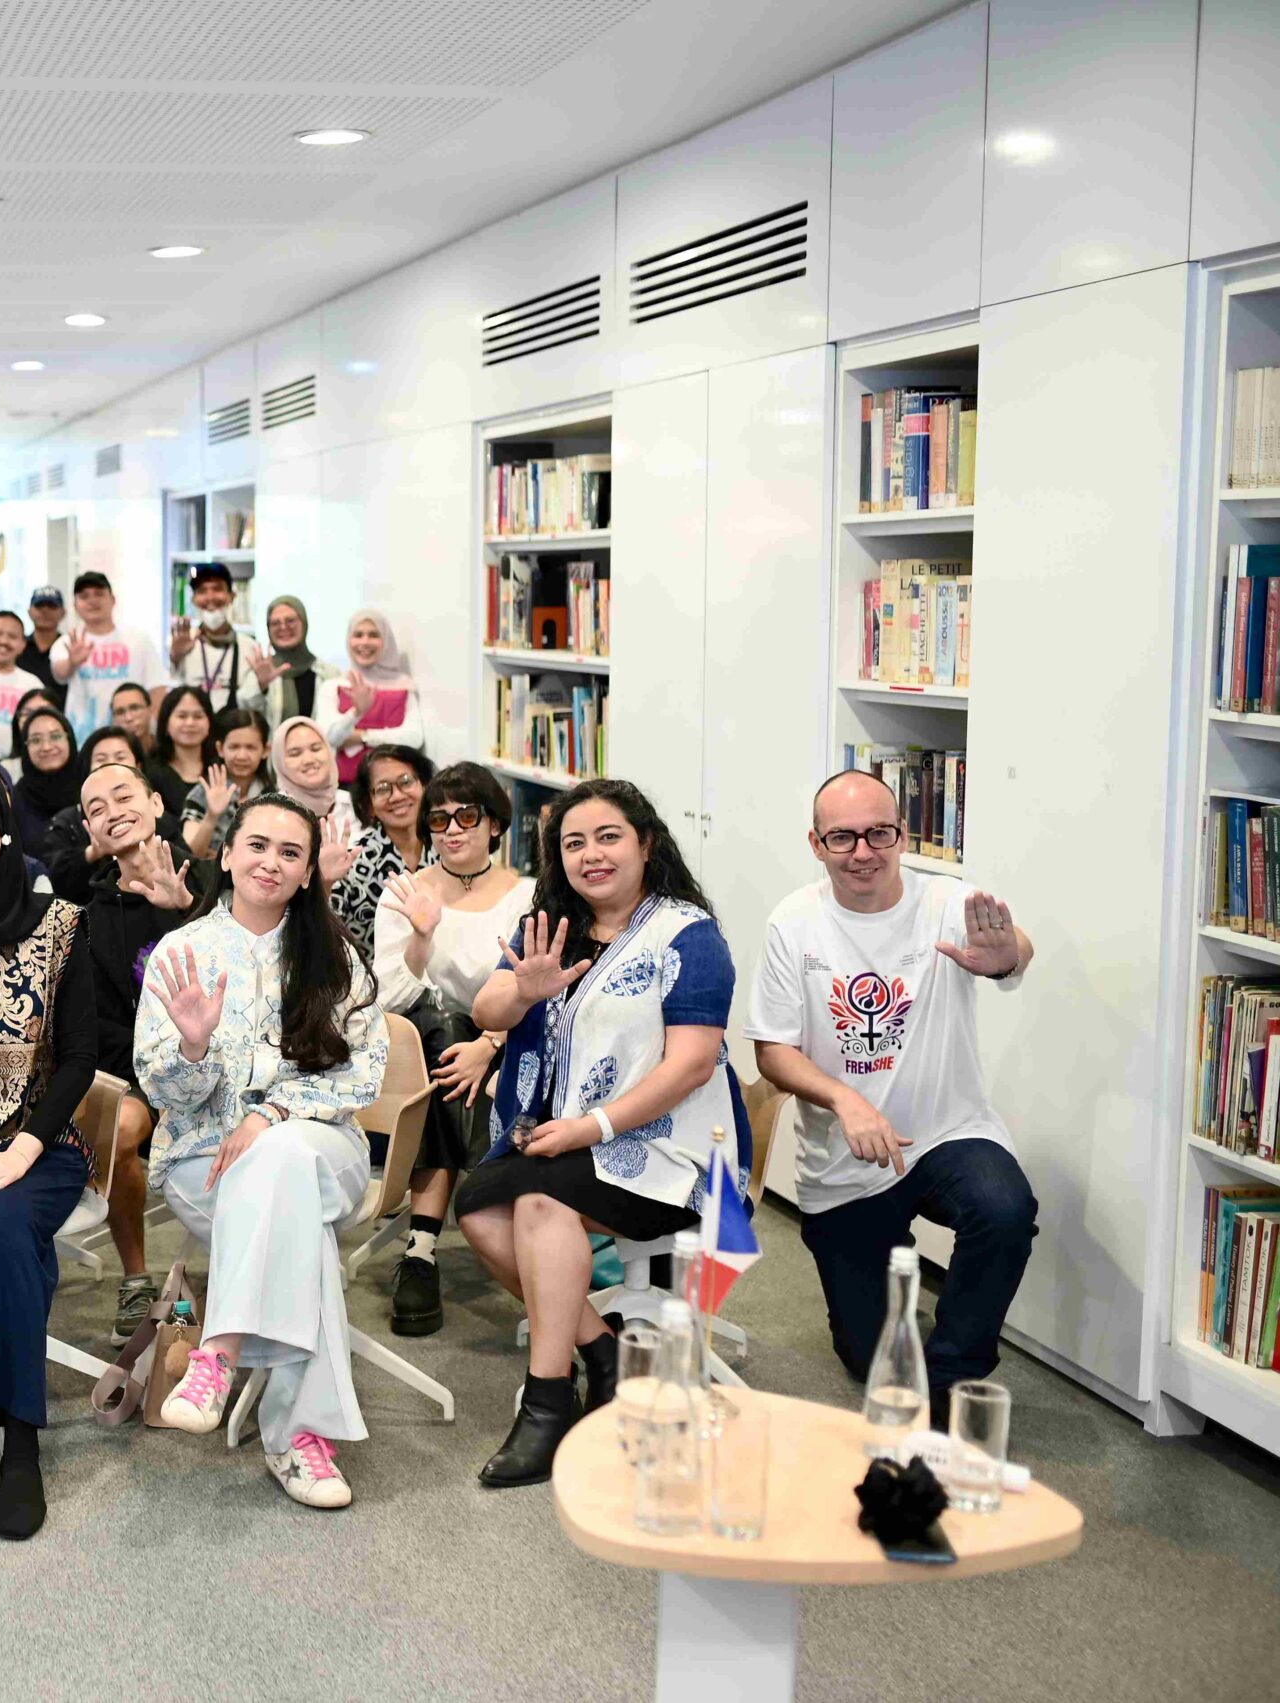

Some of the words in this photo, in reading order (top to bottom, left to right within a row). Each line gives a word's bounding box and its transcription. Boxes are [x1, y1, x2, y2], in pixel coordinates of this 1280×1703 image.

[911, 564, 925, 576] LE
[930, 563, 963, 576] PETIT
[845, 1055, 895, 1075] FRENSHE
